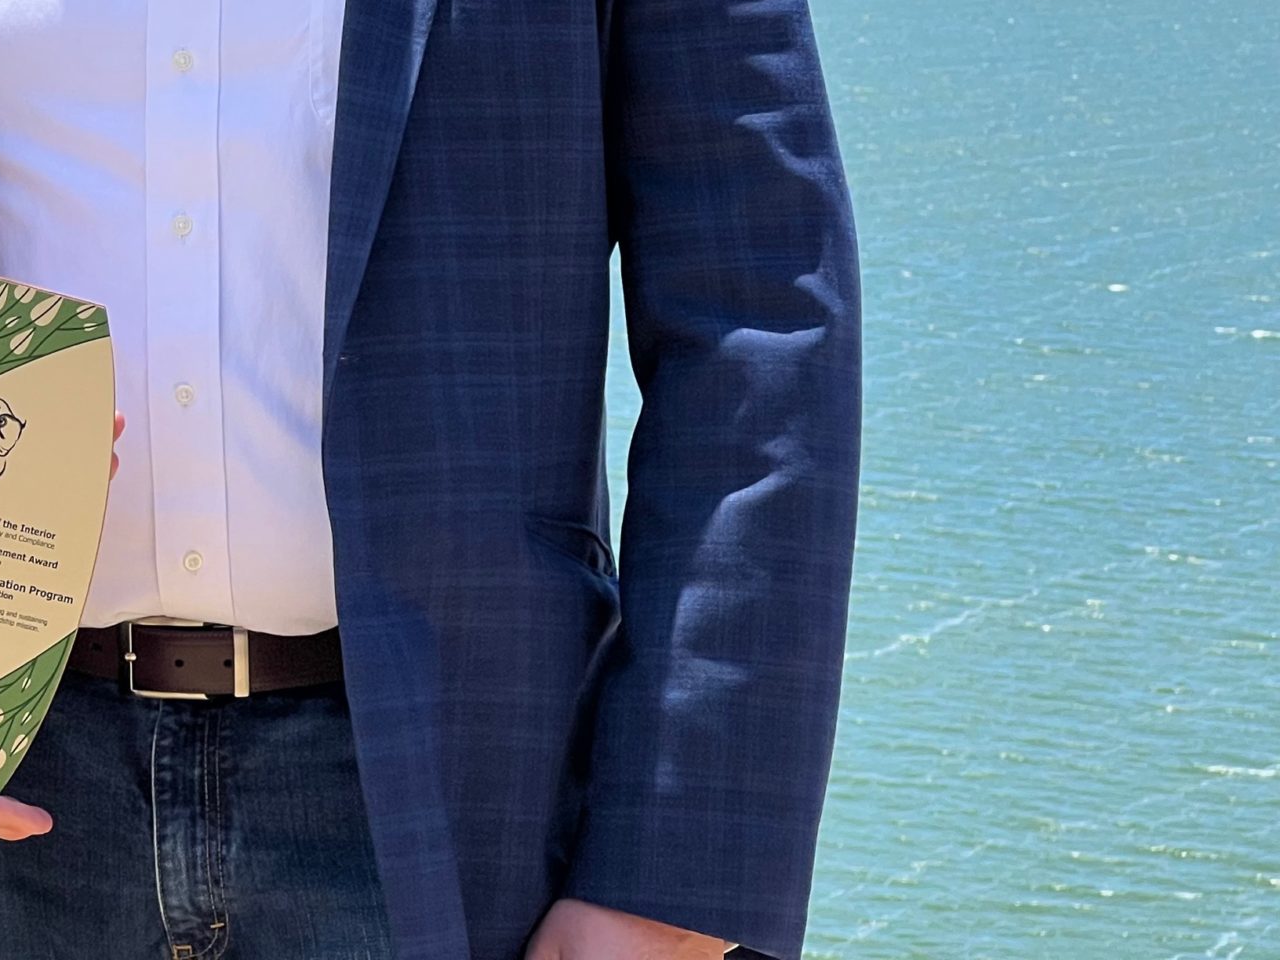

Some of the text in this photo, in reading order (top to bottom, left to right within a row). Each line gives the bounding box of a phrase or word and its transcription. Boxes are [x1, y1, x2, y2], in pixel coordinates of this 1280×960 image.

[3, 520, 18, 530] the
[20, 524, 56, 540] Interior
[4, 531, 18, 540] and
[18, 535, 55, 549] Compliance
[28, 555, 58, 569] Award
[28, 585, 74, 604] Program
[6, 610, 17, 618] and
